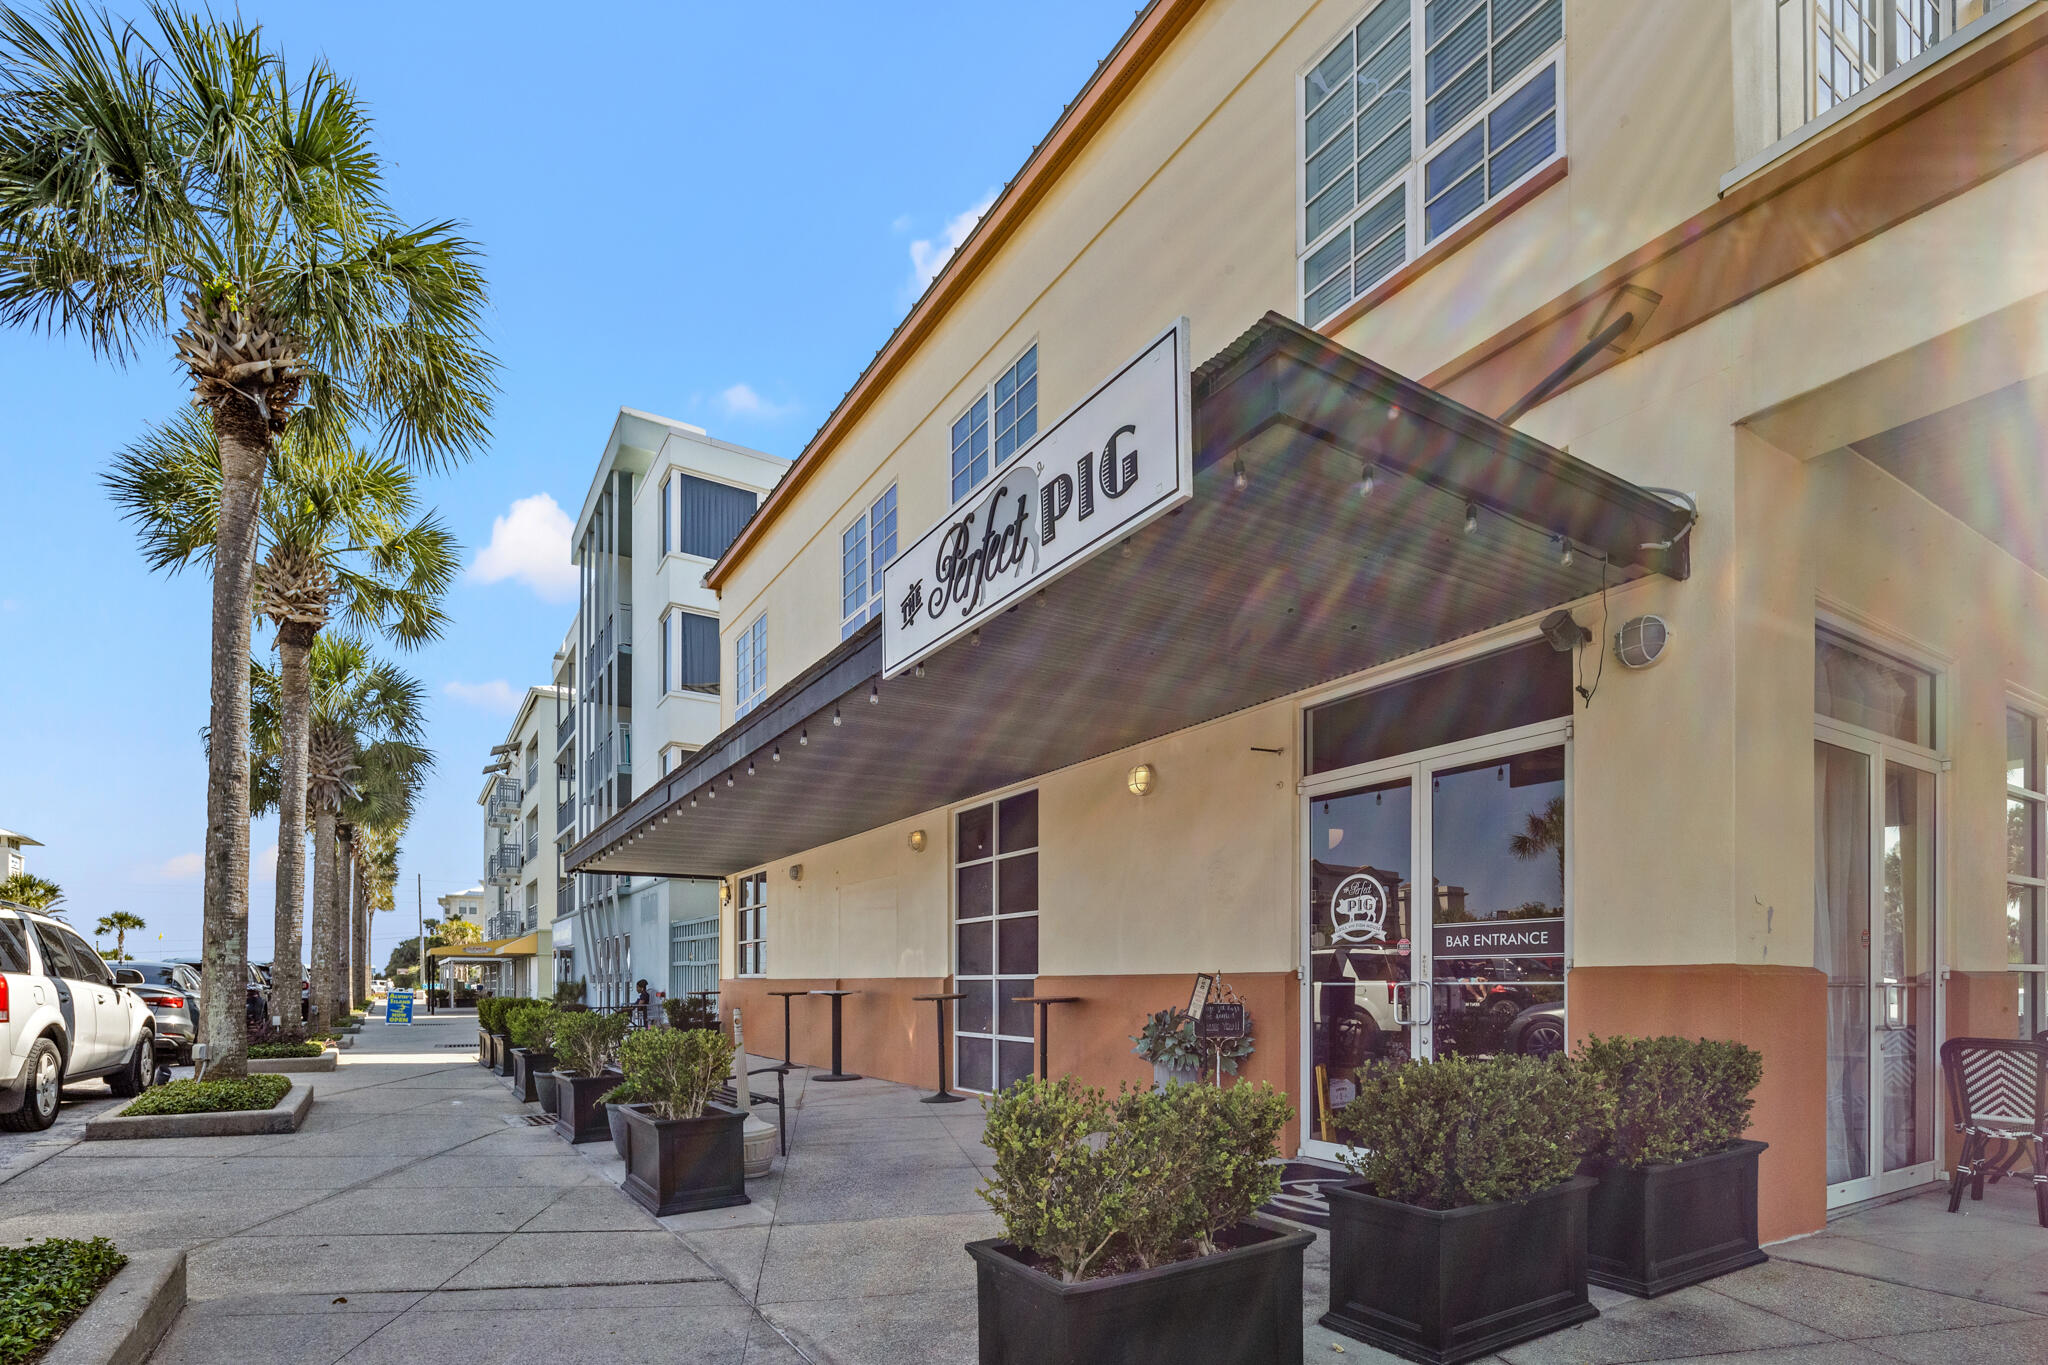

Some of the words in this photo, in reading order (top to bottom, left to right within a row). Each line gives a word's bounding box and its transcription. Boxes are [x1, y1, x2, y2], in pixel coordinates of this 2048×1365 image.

[901, 581, 922, 626] THE
[928, 486, 1029, 619] Perfect
[1040, 424, 1138, 546] PIG
[1348, 881, 1371, 896] Perfect
[1347, 898, 1373, 912] PIG
[1446, 935, 1470, 947] BAR
[1474, 931, 1548, 947] ENTRANCE
